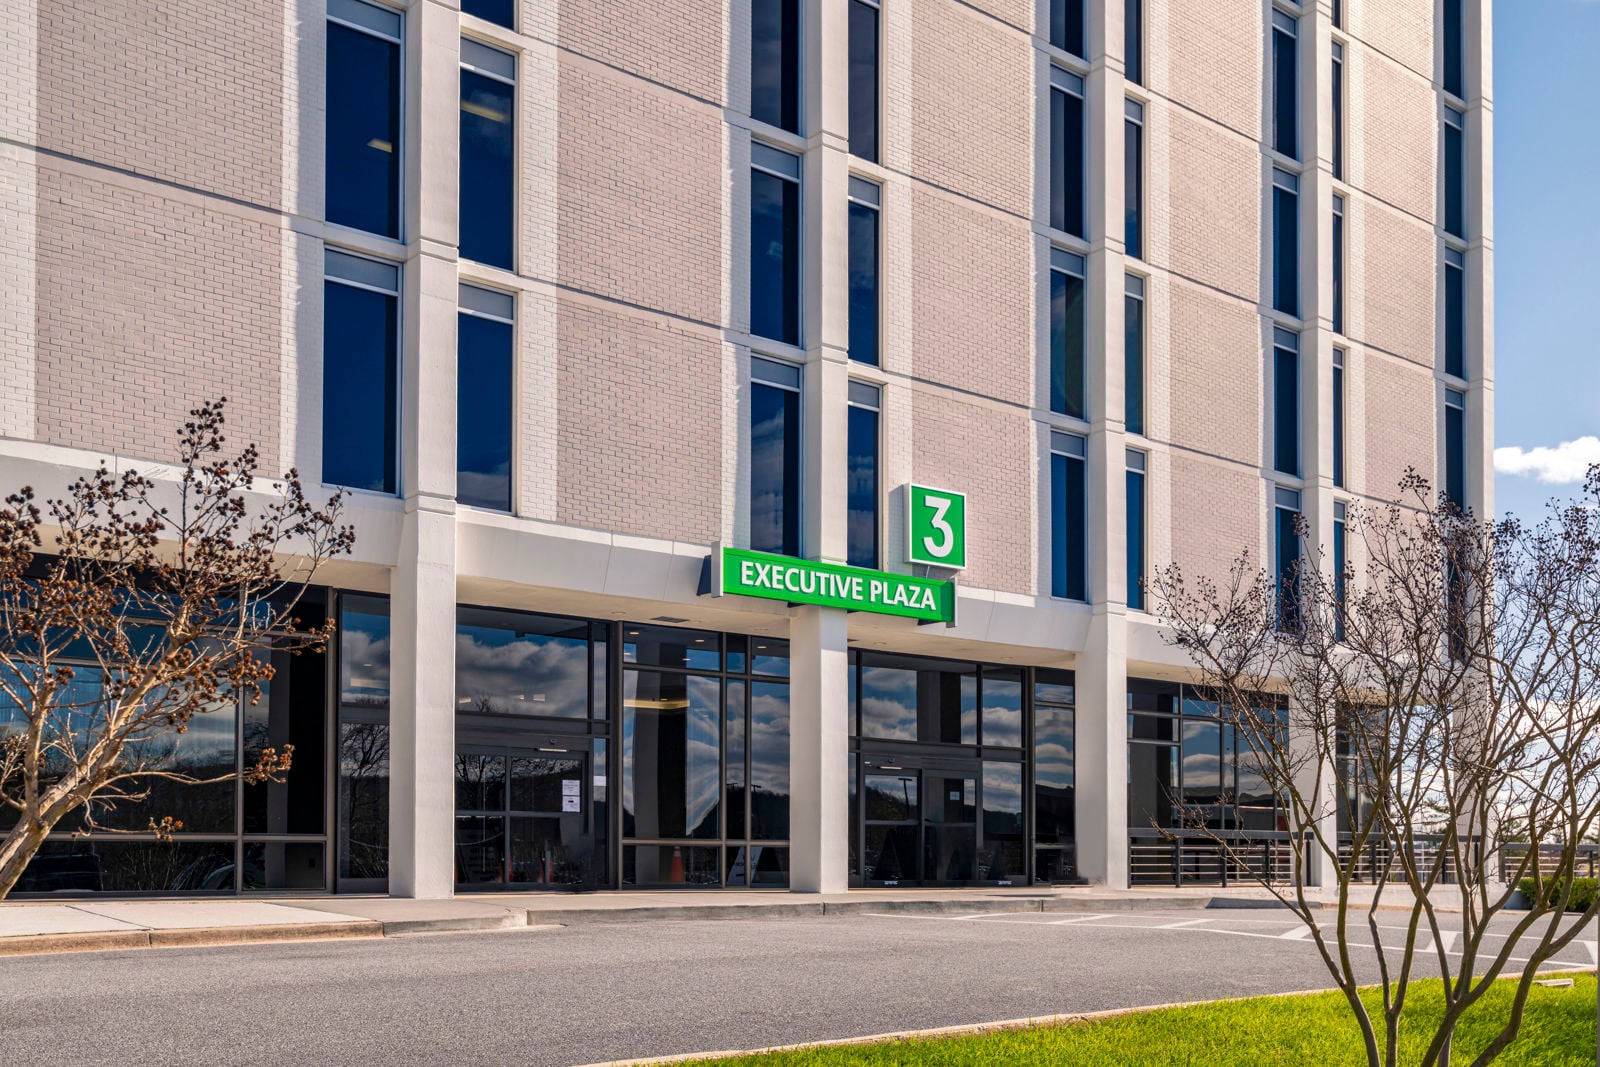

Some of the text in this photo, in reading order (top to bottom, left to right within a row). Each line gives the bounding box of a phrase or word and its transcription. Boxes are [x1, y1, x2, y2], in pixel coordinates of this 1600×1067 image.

[923, 495, 954, 557] 3
[741, 561, 936, 611] EXECUTIVE PLAZA
